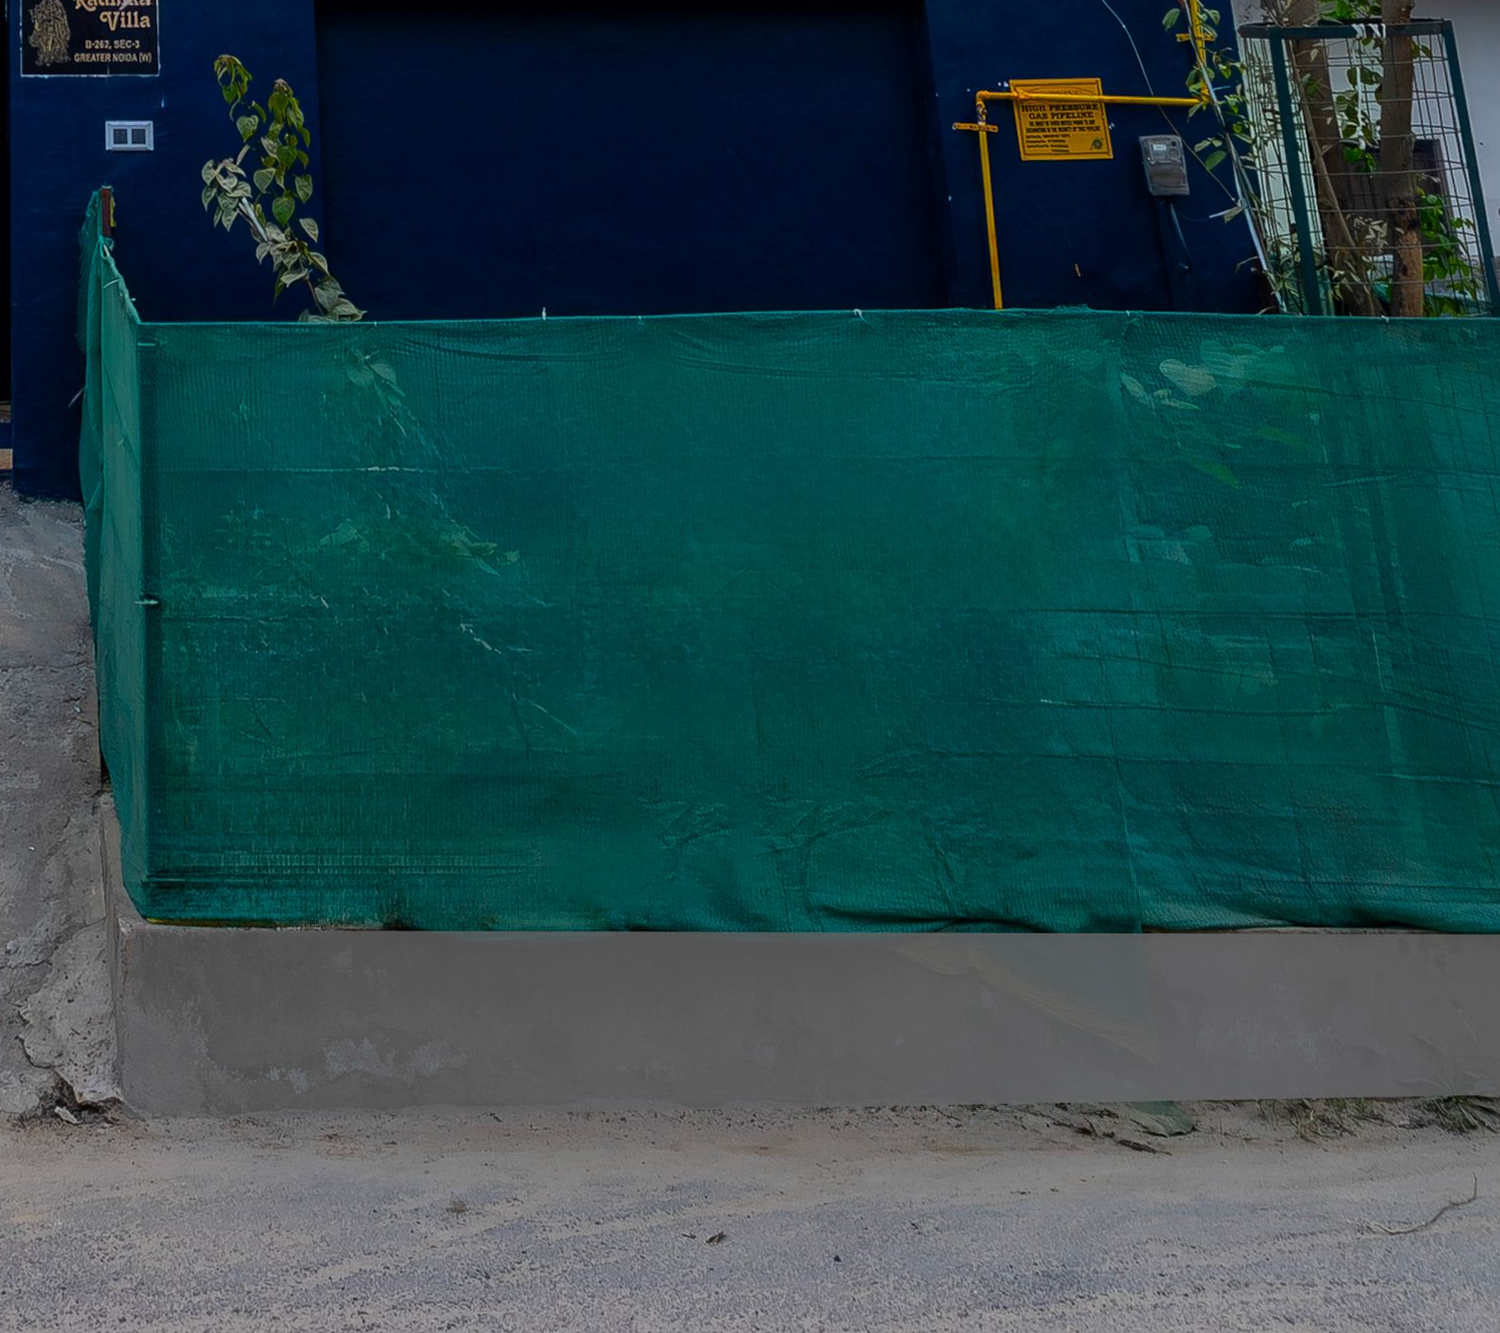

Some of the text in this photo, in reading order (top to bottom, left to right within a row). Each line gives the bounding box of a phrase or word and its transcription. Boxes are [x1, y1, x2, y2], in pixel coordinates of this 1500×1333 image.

[99, 11, 151, 31] Villa
[113, 39, 140, 49] SEC-3
[74, 53, 111, 62] GREATER
[112, 53, 137, 62] NOIDA
[1022, 104, 1046, 112] HIGH
[1029, 112, 1048, 120] GAS
